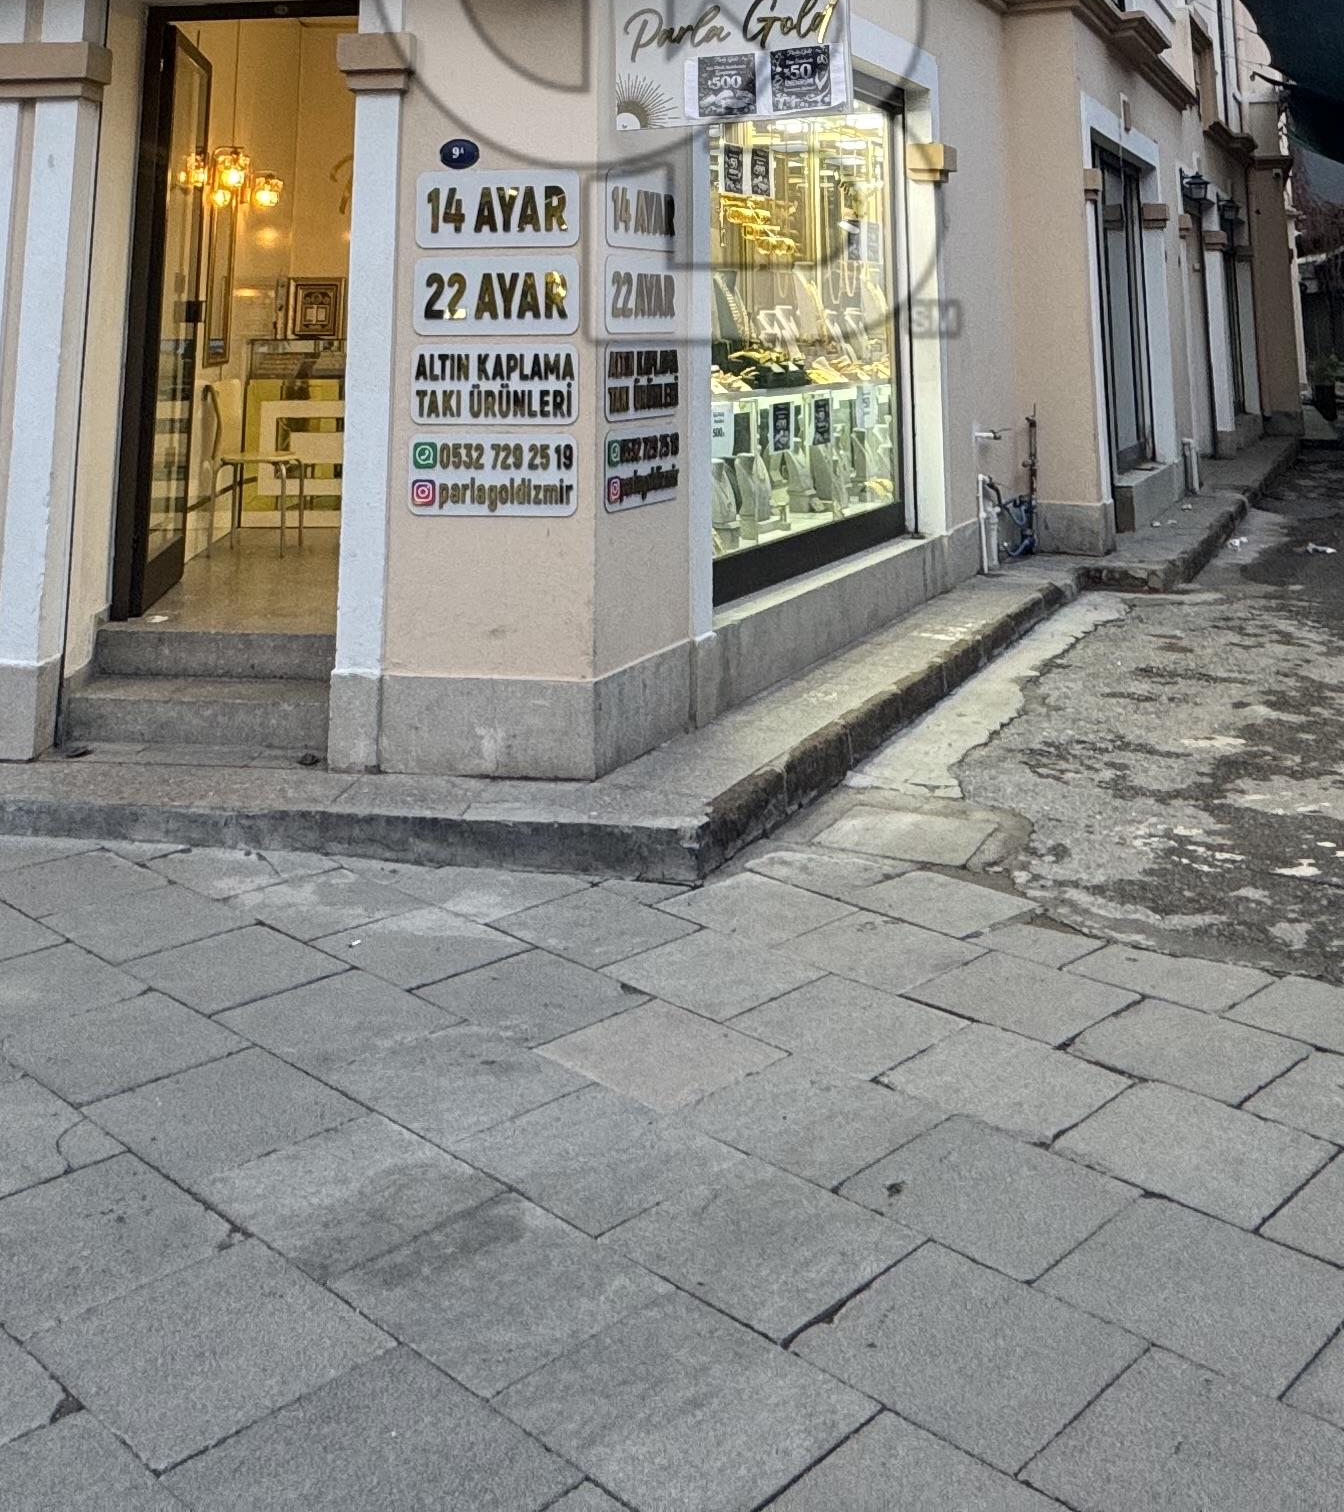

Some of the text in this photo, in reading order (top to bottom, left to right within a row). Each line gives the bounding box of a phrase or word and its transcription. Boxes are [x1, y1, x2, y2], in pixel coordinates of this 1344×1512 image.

[624, 5, 731, 63] Parla
[427, 185, 568, 233] 14 AYAR
[611, 186, 676, 237] 14 AYAR
[424, 271, 568, 320] 22 AYAR
[611, 271, 676, 319] 22 AYAR
[415, 352, 575, 381] ALTIN KAPLAMA
[416, 382, 573, 418] TAKI ÜRÜNLERİ
[439, 442, 573, 470] 0532 729 25 19
[438, 477, 573, 512] parlagoldizmir
